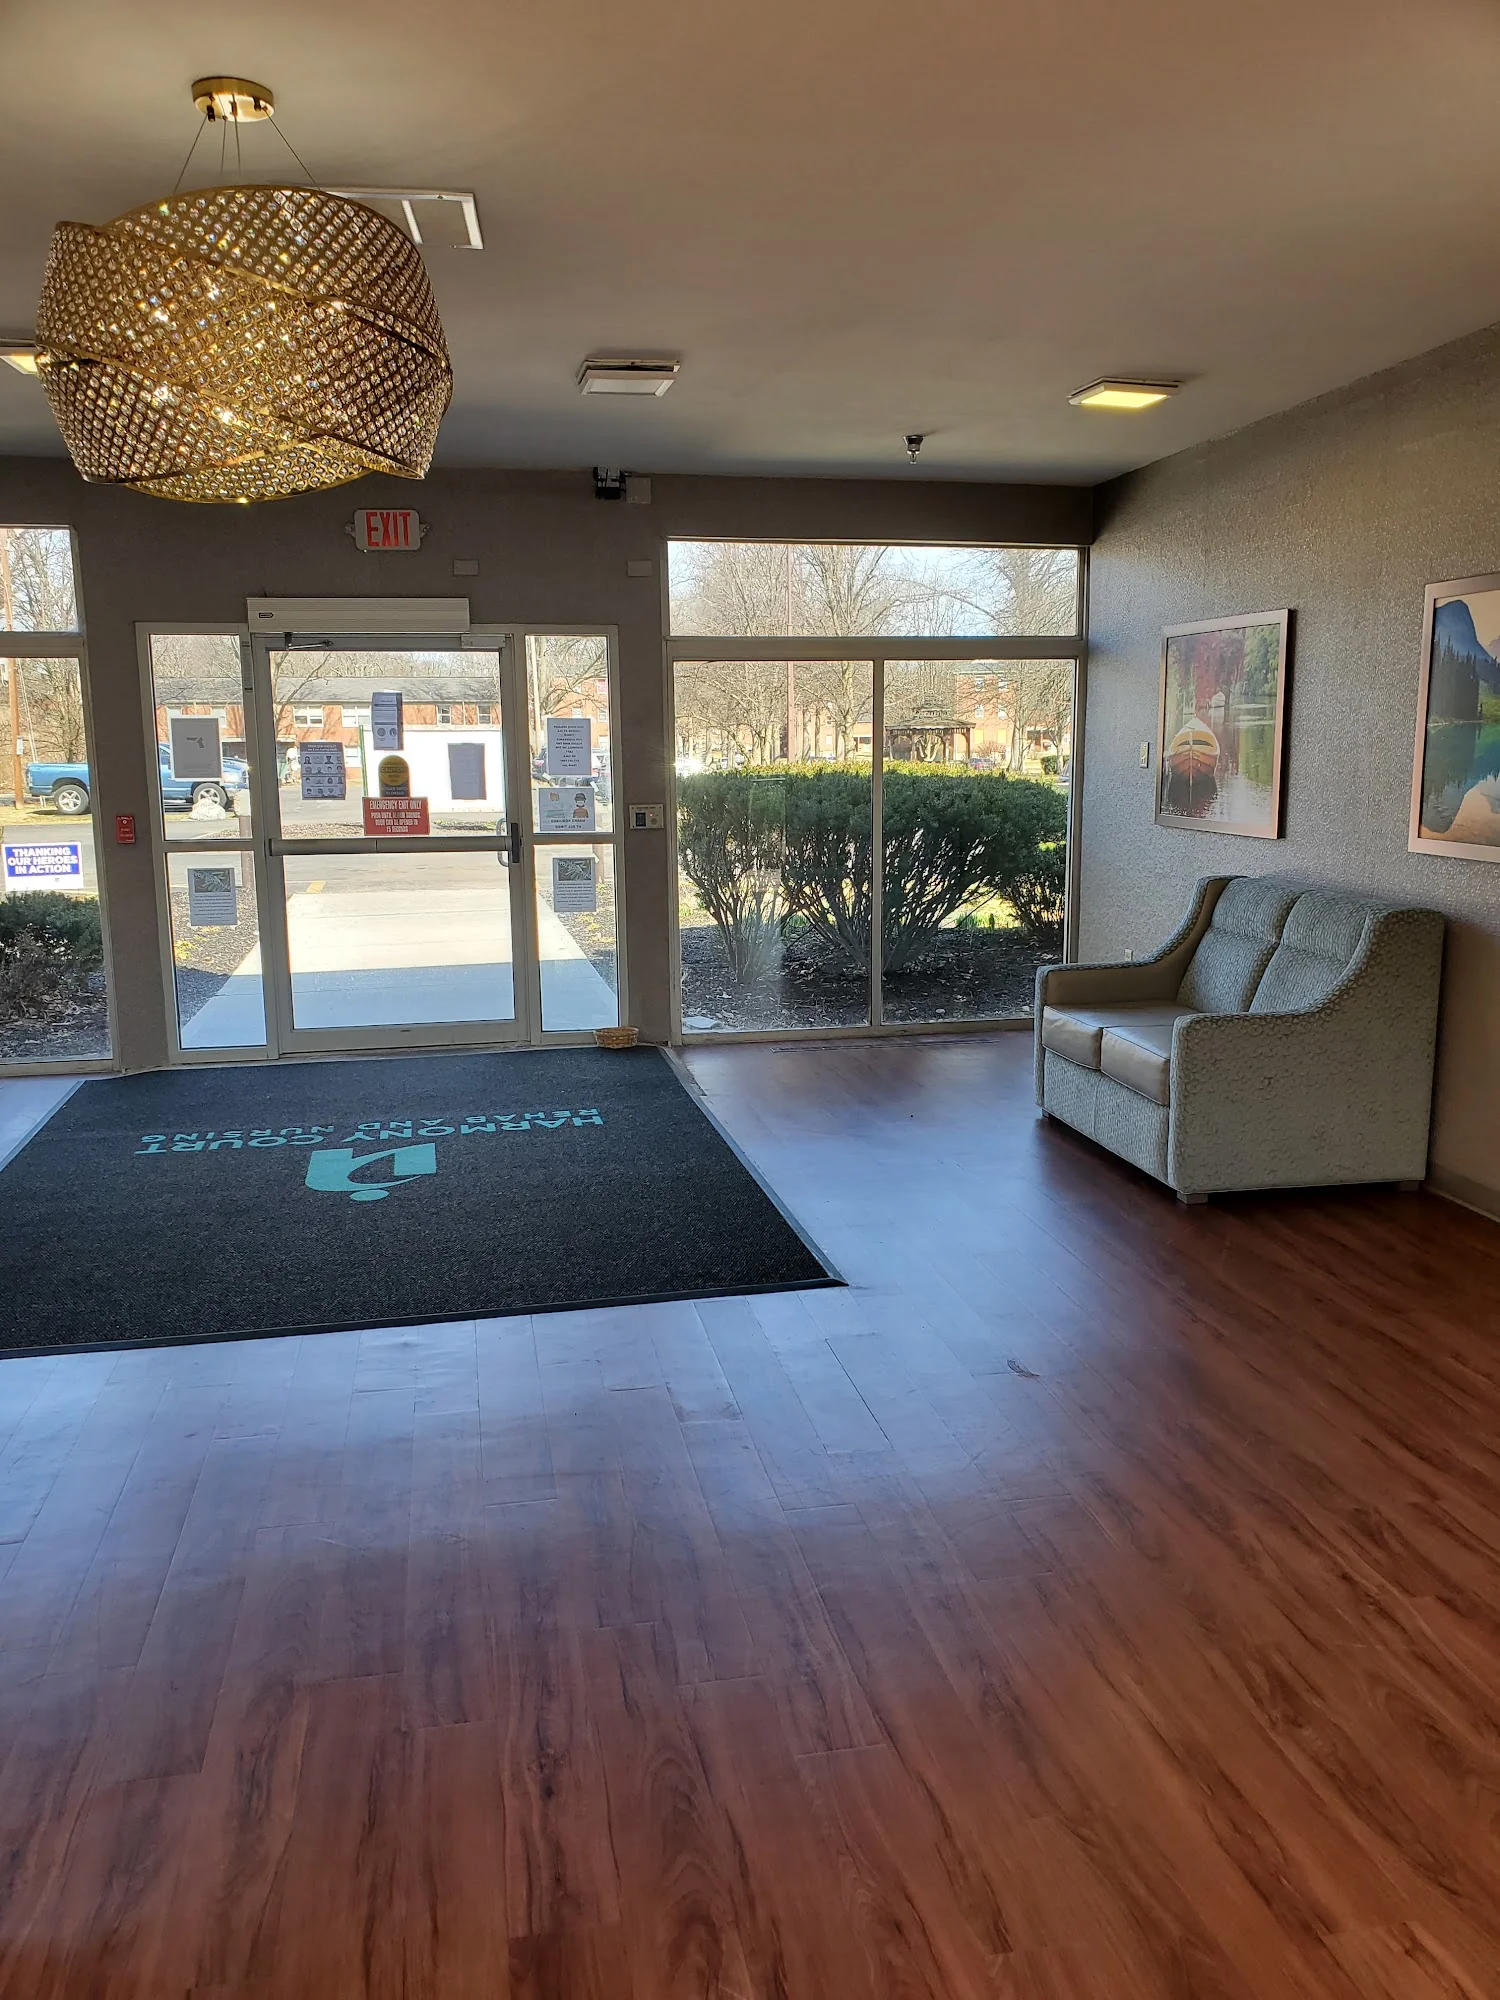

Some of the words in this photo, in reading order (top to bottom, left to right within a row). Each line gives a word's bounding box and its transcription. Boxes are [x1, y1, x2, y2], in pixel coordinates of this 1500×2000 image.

[366, 511, 411, 547] EXIT
[369, 800, 397, 810] EMERGENCY
[398, 800, 409, 810] EXIT
[410, 800, 422, 810] ONLY
[12, 847, 71, 857] THANKING
[7, 857, 32, 866] OUR
[32, 855, 79, 865] HEROES
[15, 865, 27, 875] IN
[29, 864, 71, 874] ACTION
[466, 1108, 599, 1124] REHAB
[341, 1116, 604, 1143] HARMONY
[357, 1118, 444, 1131] AND
[141, 1125, 335, 1144] NURSING
[134, 1135, 325, 1155] COURT
